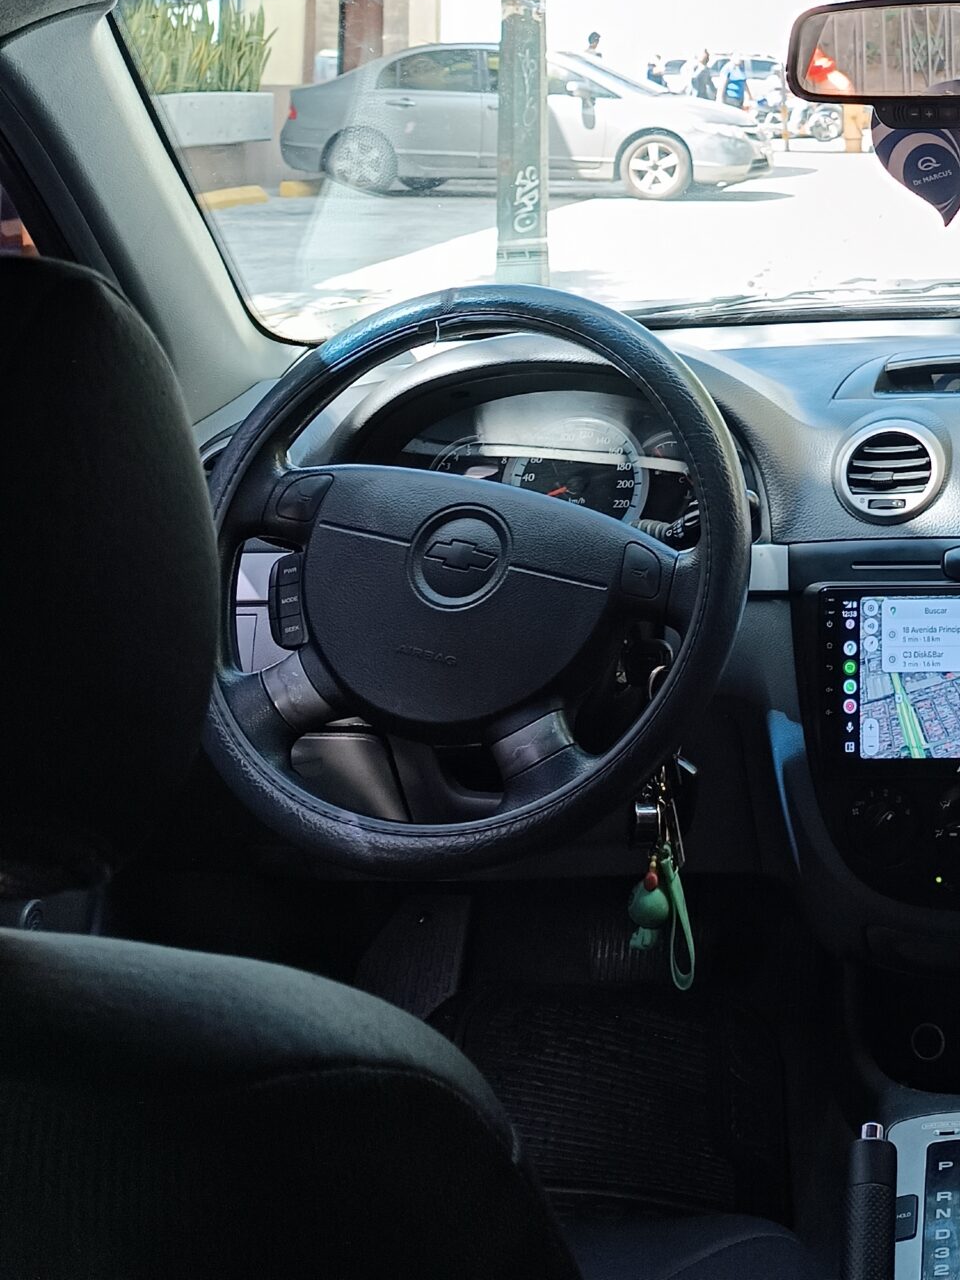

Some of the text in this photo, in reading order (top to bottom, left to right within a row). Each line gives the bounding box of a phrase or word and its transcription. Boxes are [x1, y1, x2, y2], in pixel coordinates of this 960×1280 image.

[466, 448, 472, 456] 5
[445, 462, 451, 470] 3
[616, 462, 632, 471] 180
[522, 473, 535, 482] 40
[616, 480, 635, 489] 200
[612, 500, 630, 508] 220
[283, 566, 297, 574] PWR
[281, 595, 298, 604] MODE
[924, 607, 947, 615] Buscar
[284, 625, 299, 634] SEEK
[938, 1161, 953, 1170] P
[936, 1192, 952, 1202] R
[936, 1208, 950, 1218] N
[935, 1229, 950, 1240] D
[934, 1247, 950, 1258] 3
[934, 1265, 949, 1276] 2
